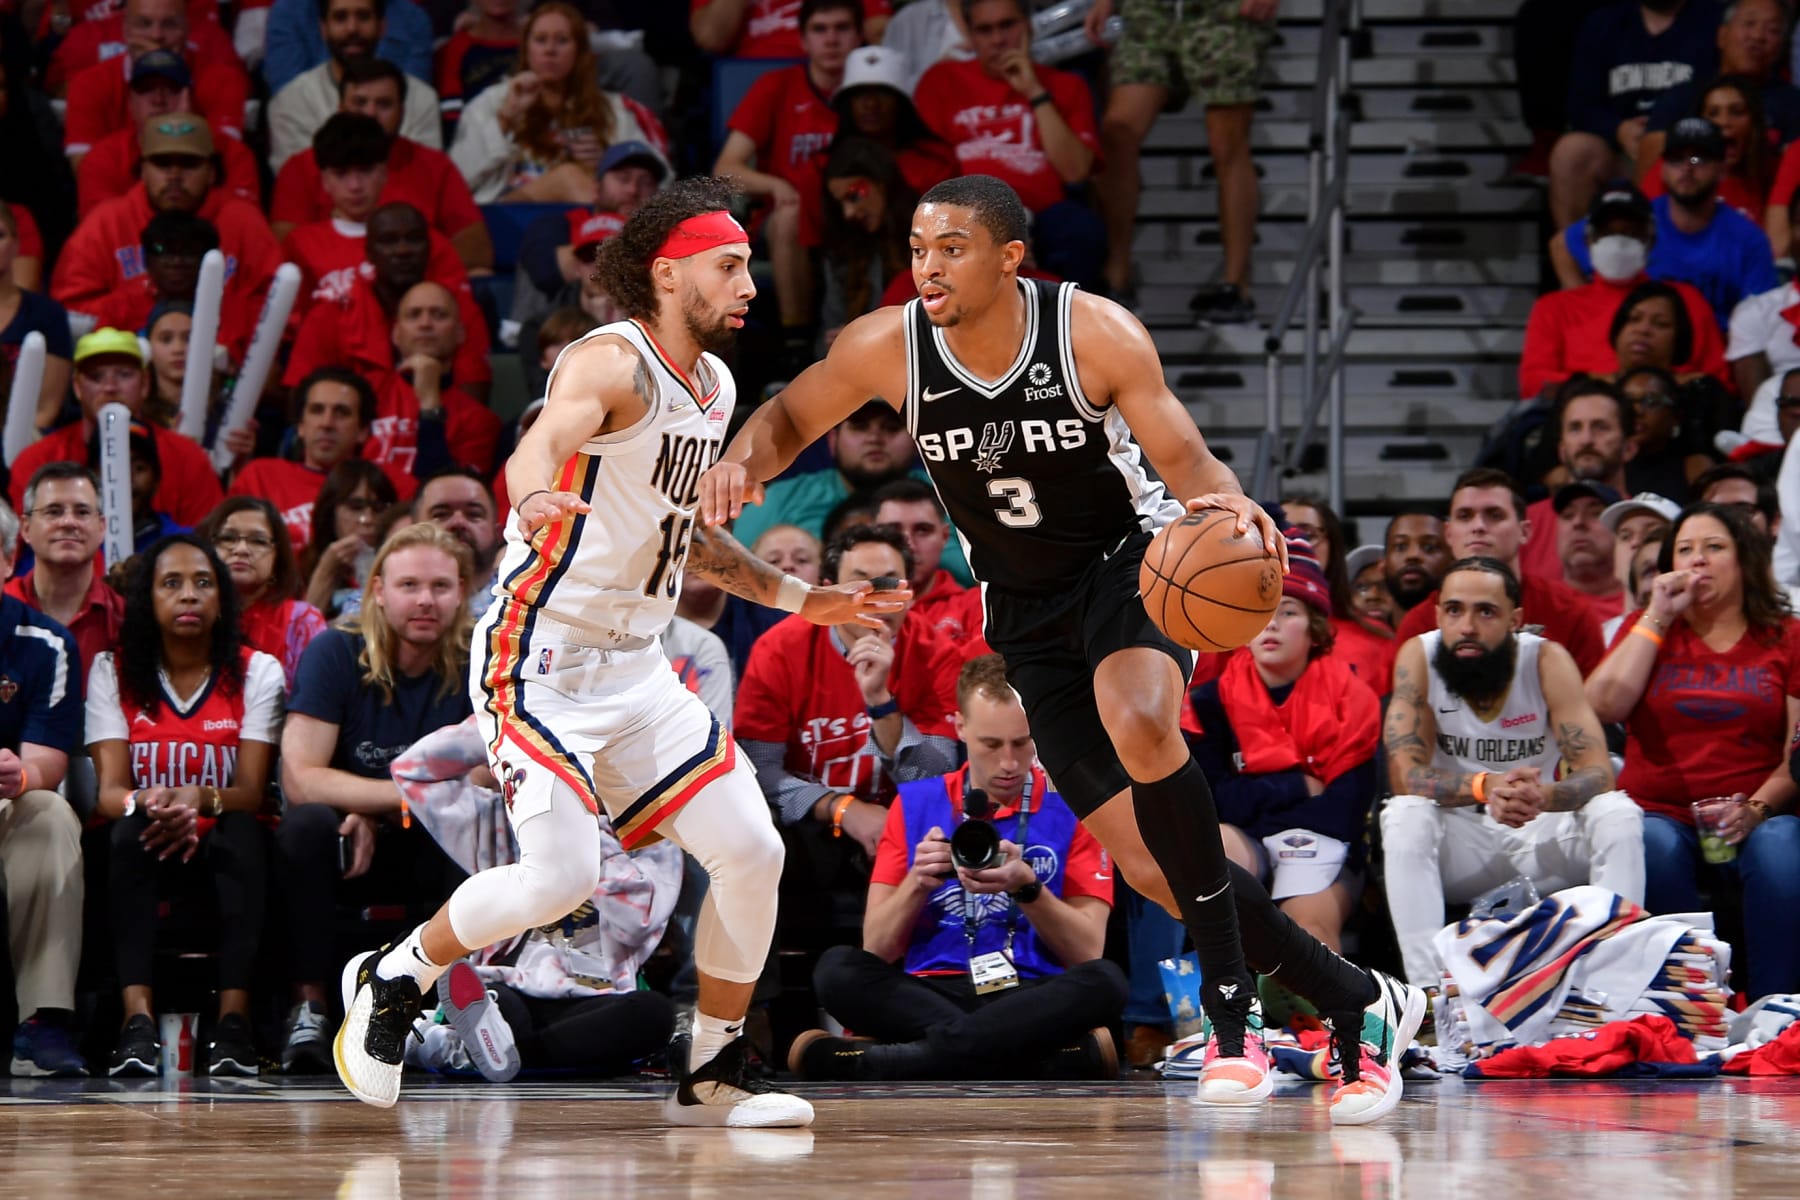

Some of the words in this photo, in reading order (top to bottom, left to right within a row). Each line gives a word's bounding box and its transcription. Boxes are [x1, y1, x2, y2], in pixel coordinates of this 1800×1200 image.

[1024, 383, 1064, 402] Frost
[918, 418, 1087, 475] SPURS
[985, 476, 1043, 528] 3
[1501, 713, 1537, 729] ibotta
[129, 741, 236, 789] ELICAN
[1476, 736, 1545, 762] ORLEANS
